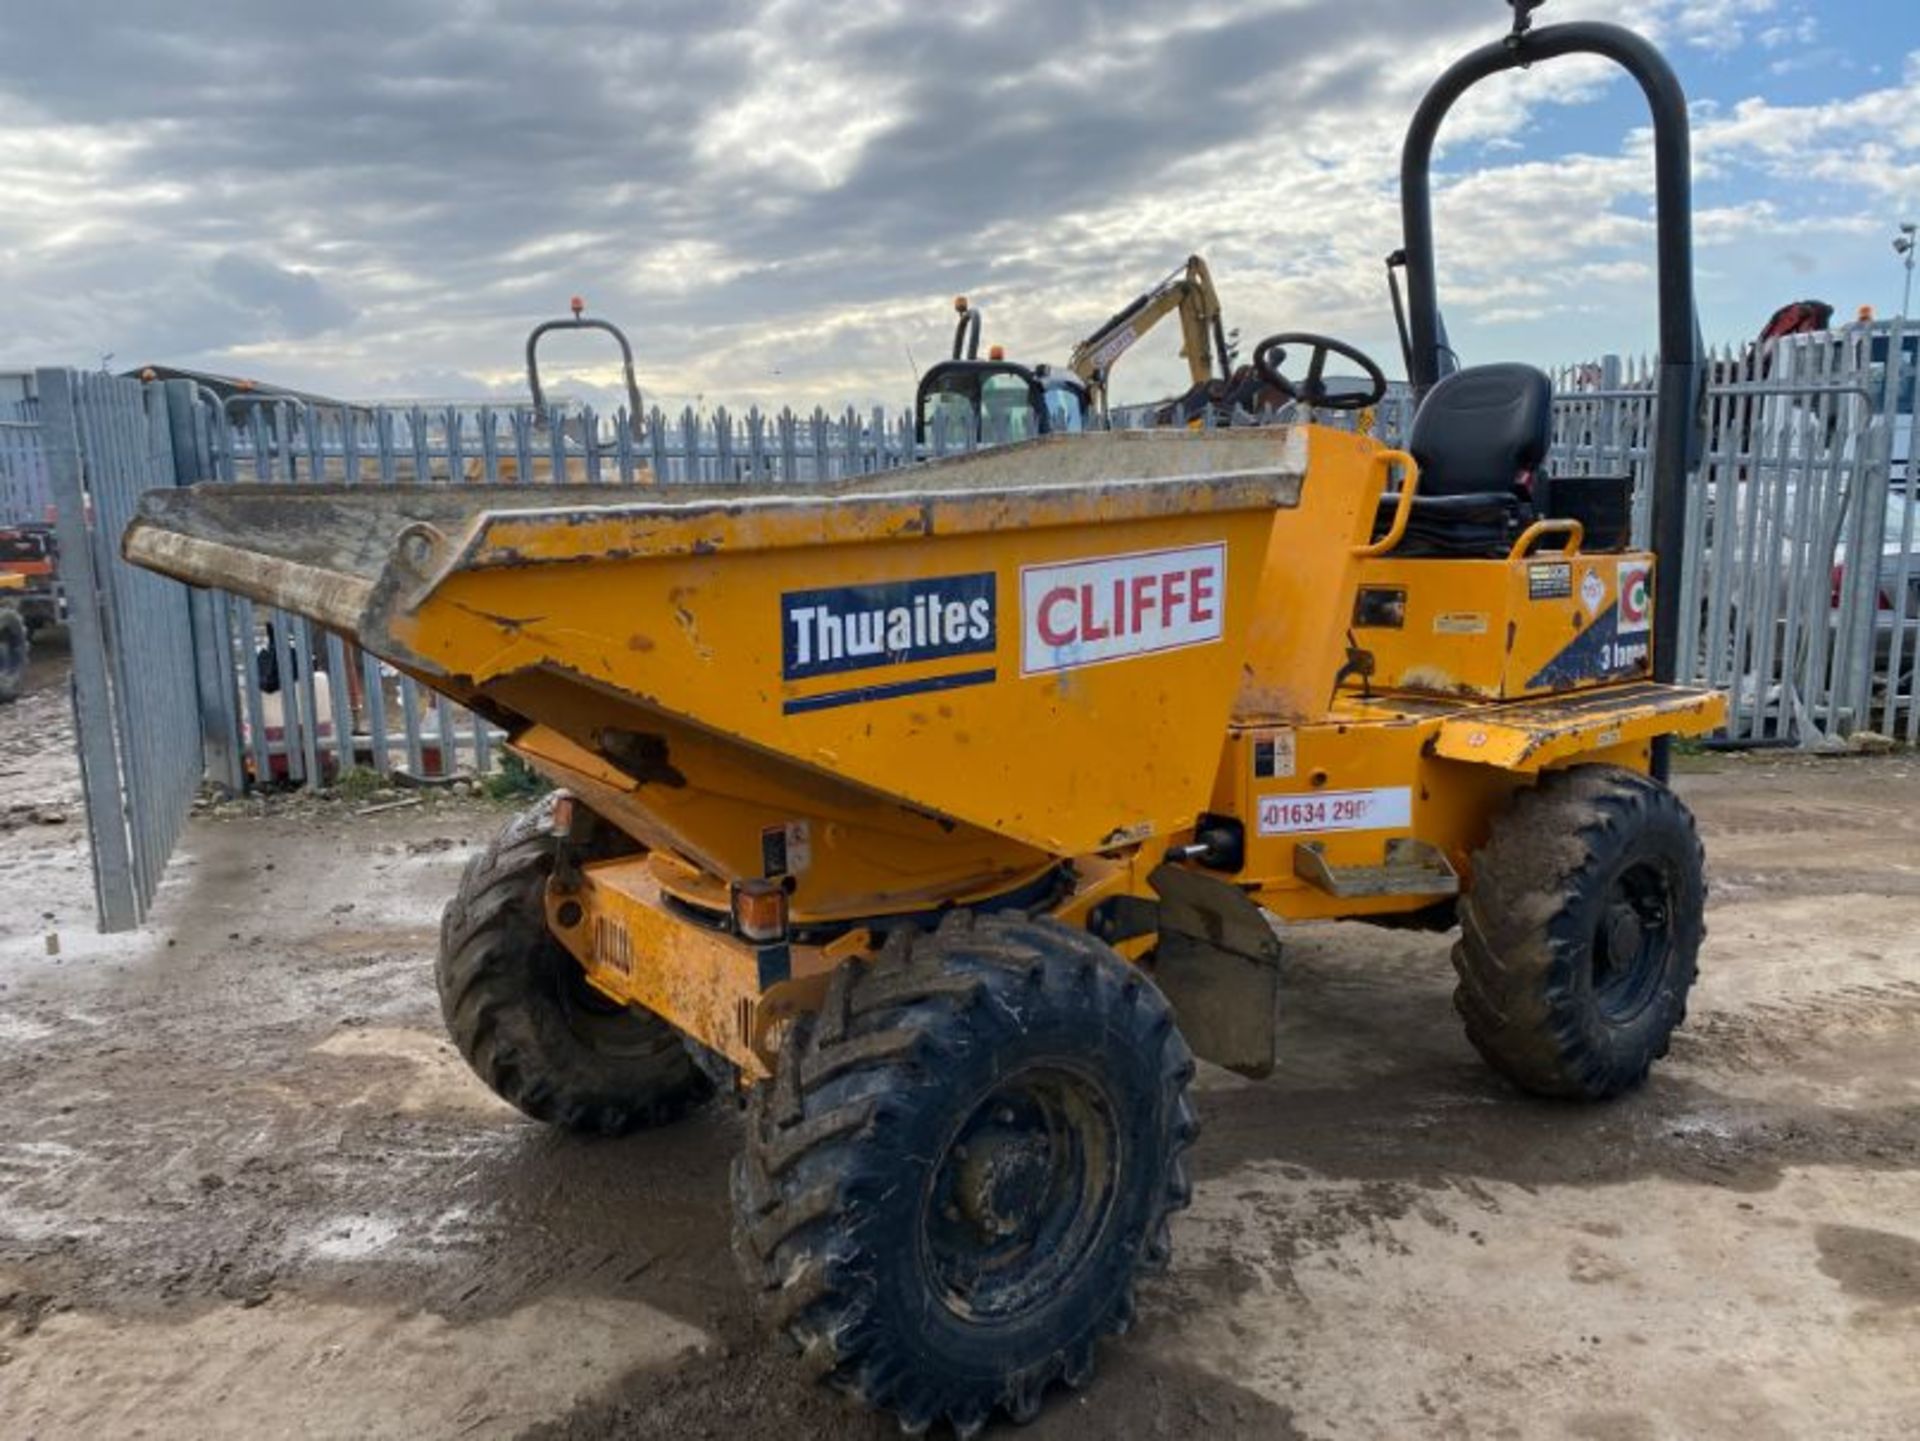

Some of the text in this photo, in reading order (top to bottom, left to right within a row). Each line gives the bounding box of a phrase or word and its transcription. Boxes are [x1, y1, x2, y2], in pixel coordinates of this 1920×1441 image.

[790, 595, 990, 664] Thwaites
[1037, 567, 1214, 648] CLIFFE
[1600, 644, 1611, 670] 3
[1267, 802, 1326, 826] 01634
